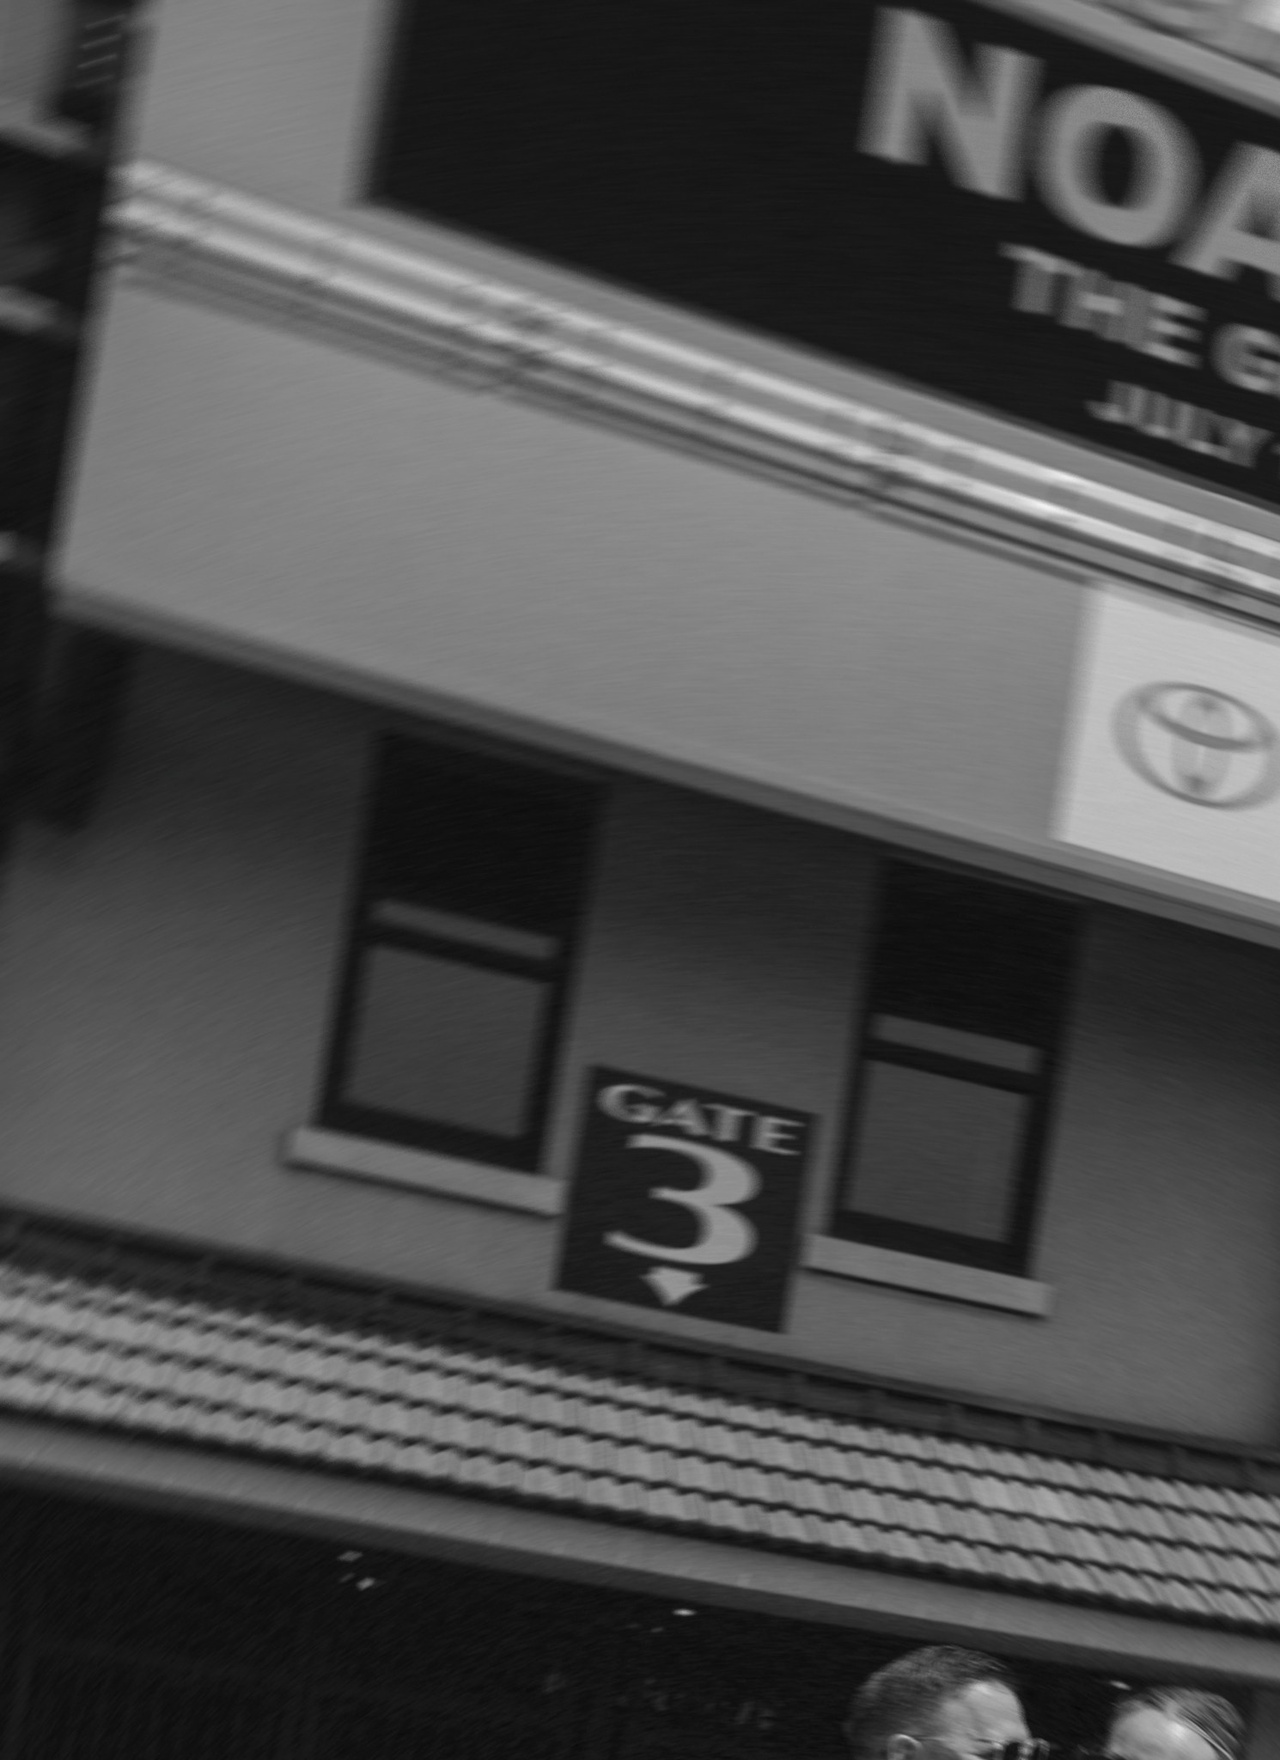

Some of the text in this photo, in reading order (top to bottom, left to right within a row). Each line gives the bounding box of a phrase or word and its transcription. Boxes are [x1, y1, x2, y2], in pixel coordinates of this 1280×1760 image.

[1001, 241, 1207, 369] THE
[1084, 379, 1275, 468] JULY
[598, 1083, 805, 1156] GATE
[603, 1133, 761, 1264] 3
